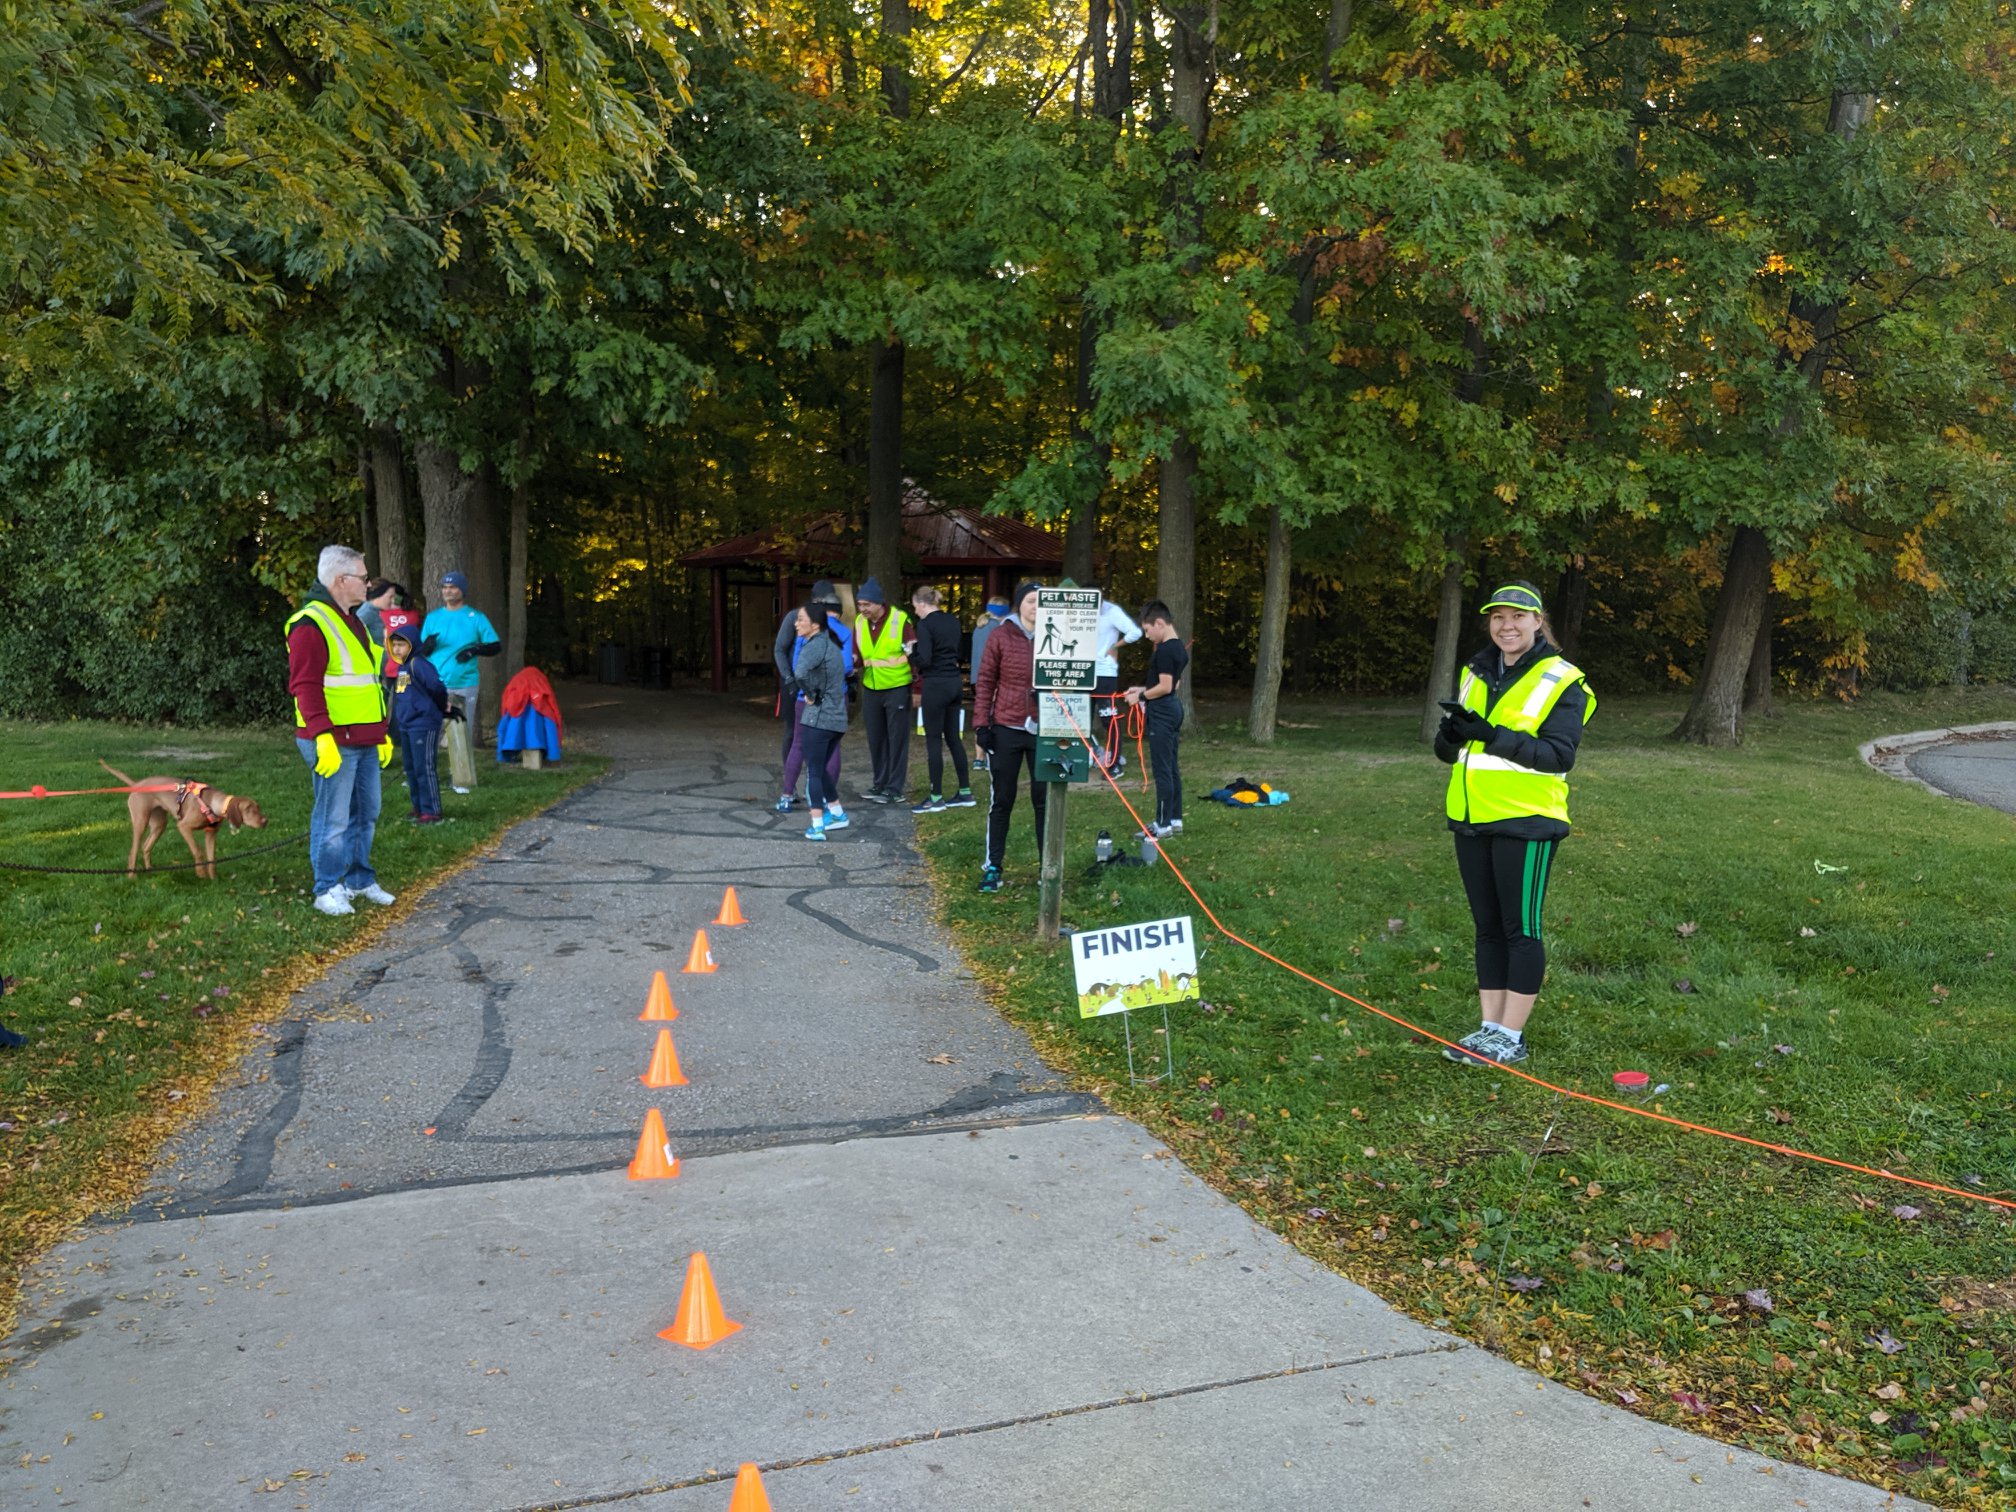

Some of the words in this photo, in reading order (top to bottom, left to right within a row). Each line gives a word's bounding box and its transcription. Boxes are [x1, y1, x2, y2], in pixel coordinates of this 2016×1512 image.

[1041, 592, 1060, 601] PET
[1063, 593, 1097, 602] WASTE
[1038, 661, 1068, 669] PLEASE
[1044, 670, 1062, 678] THIS
[1082, 921, 1184, 959] FINISH
